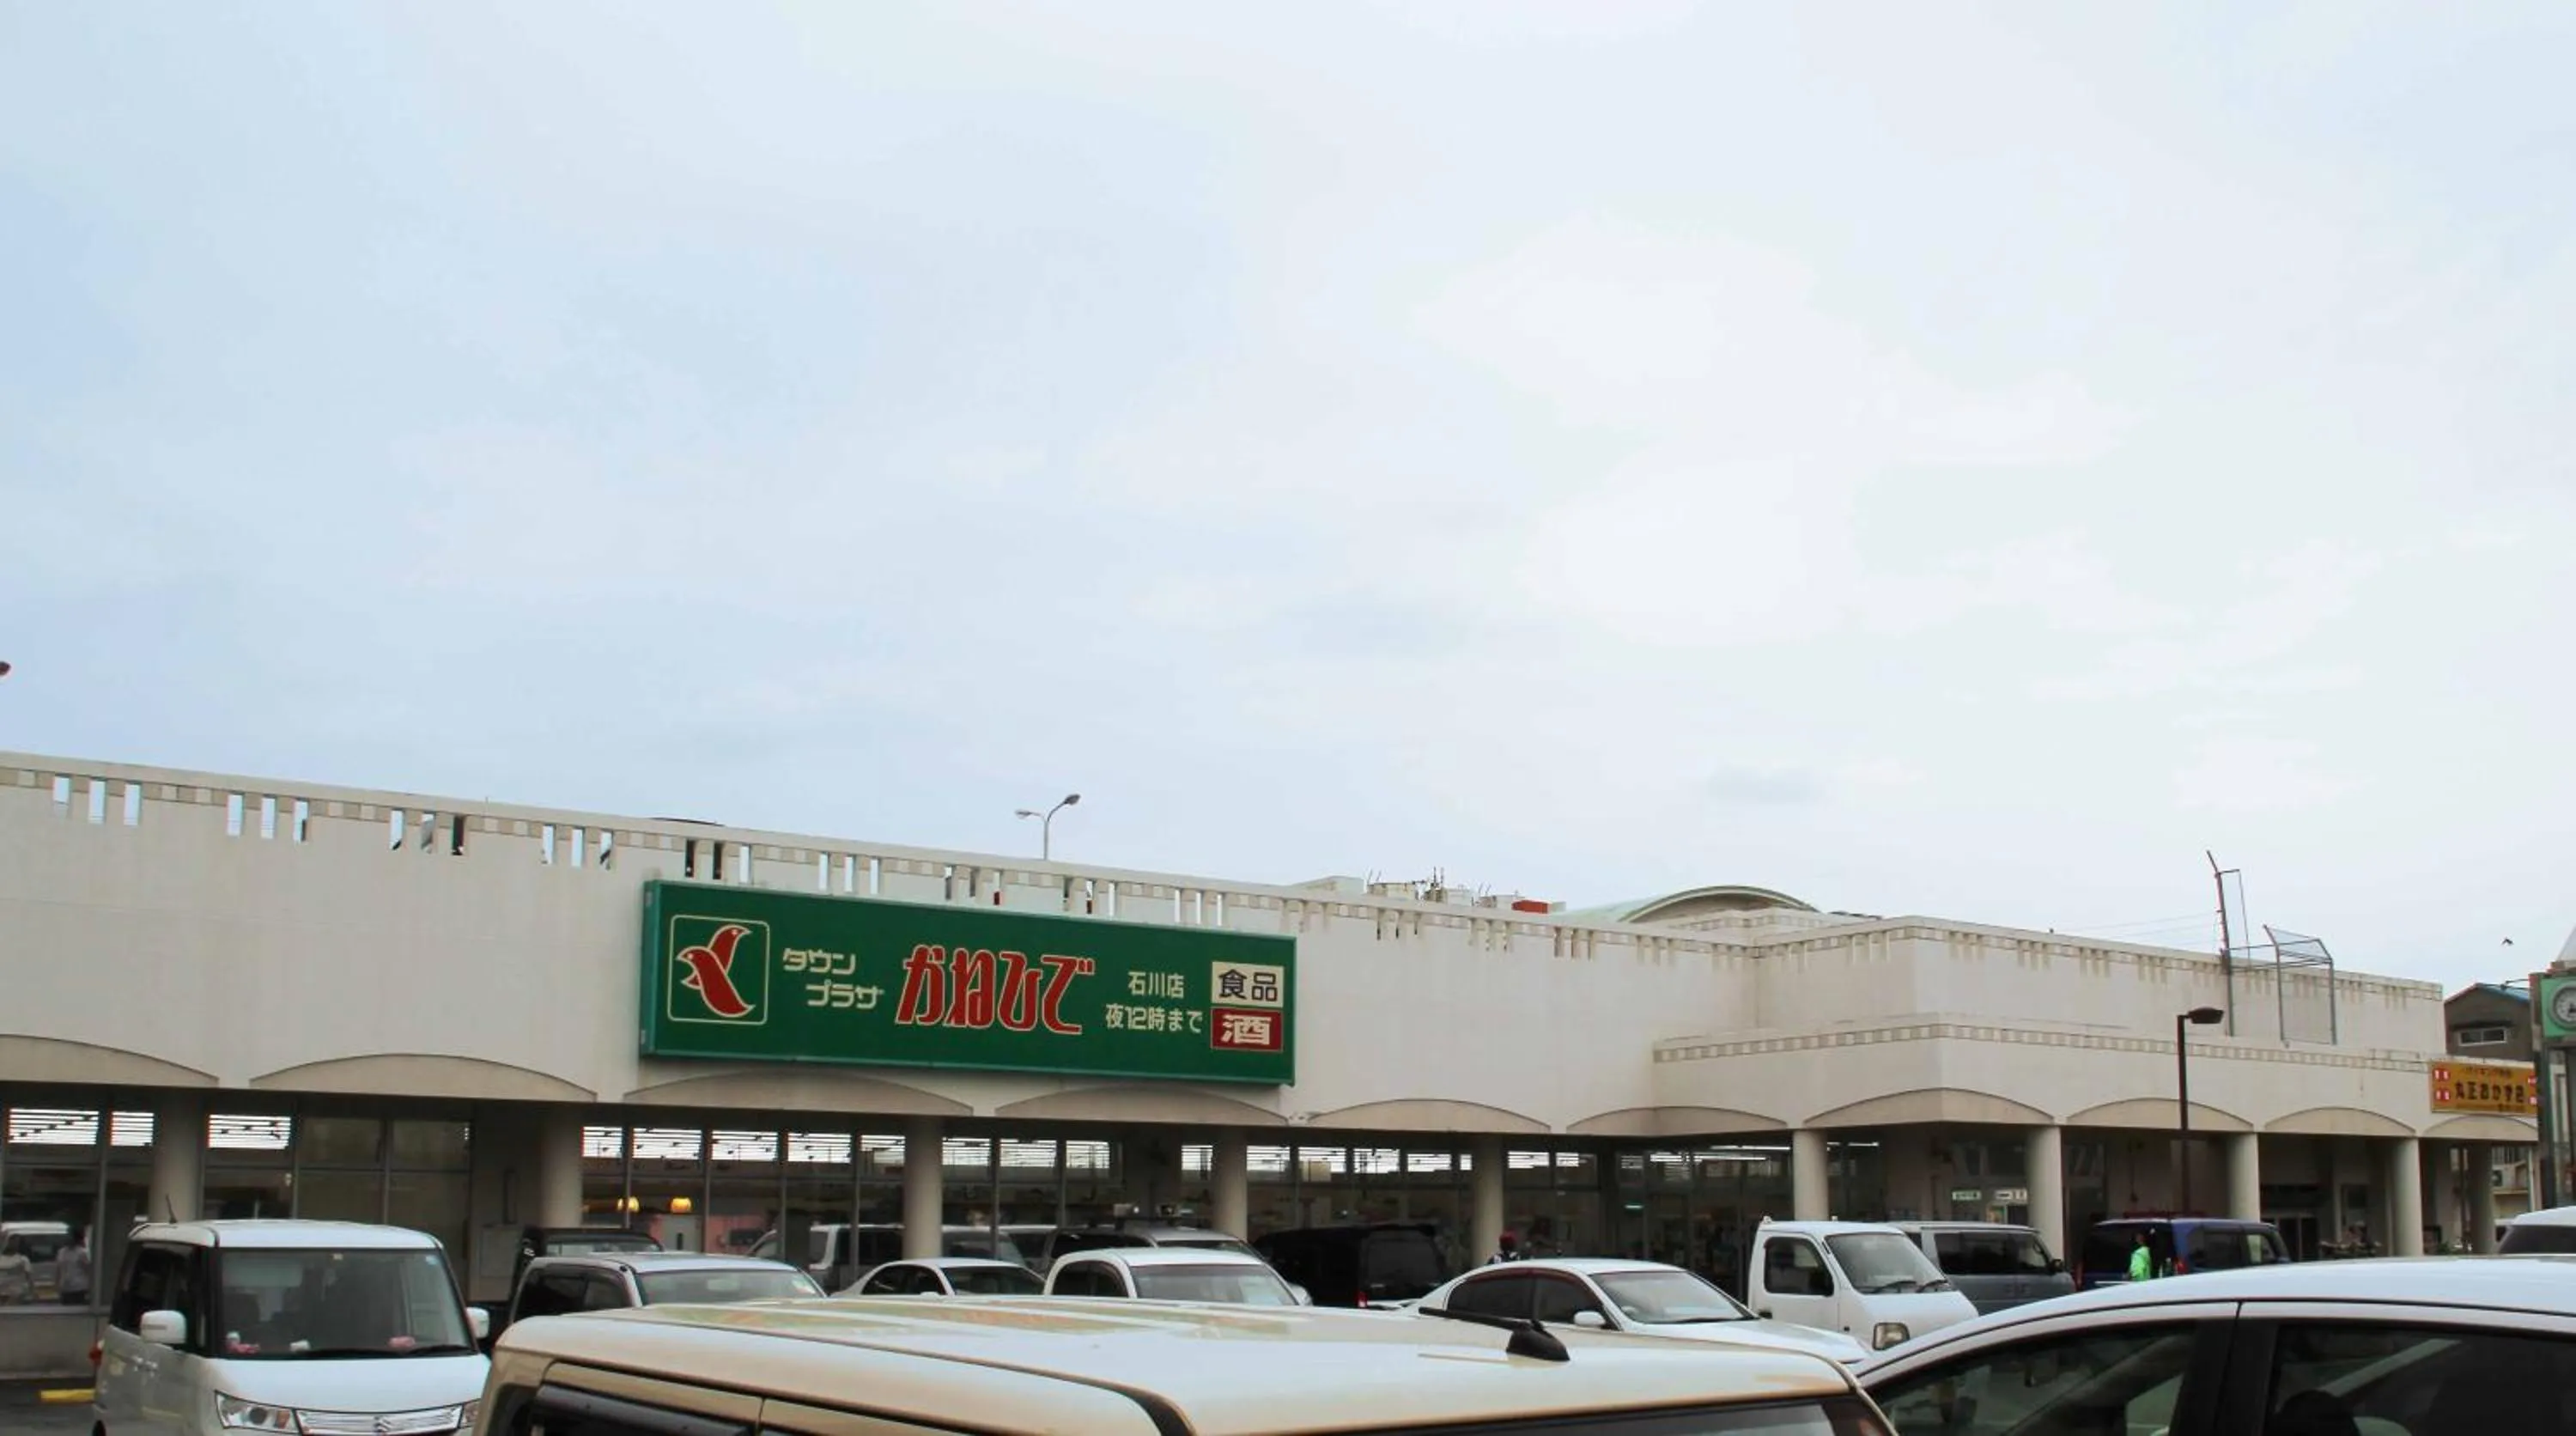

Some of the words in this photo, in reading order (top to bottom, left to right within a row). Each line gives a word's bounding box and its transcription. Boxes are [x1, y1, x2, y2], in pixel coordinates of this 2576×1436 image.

[782, 947, 856, 976] タウン
[805, 978, 885, 1009] プラザ
[895, 945, 1095, 1035] かねひで
[1127, 971, 1185, 999] 石川店
[1218, 968, 1278, 1002] 食品
[1104, 1003, 1203, 1034] 夜12時まで
[1219, 1013, 1273, 1045] 酒
